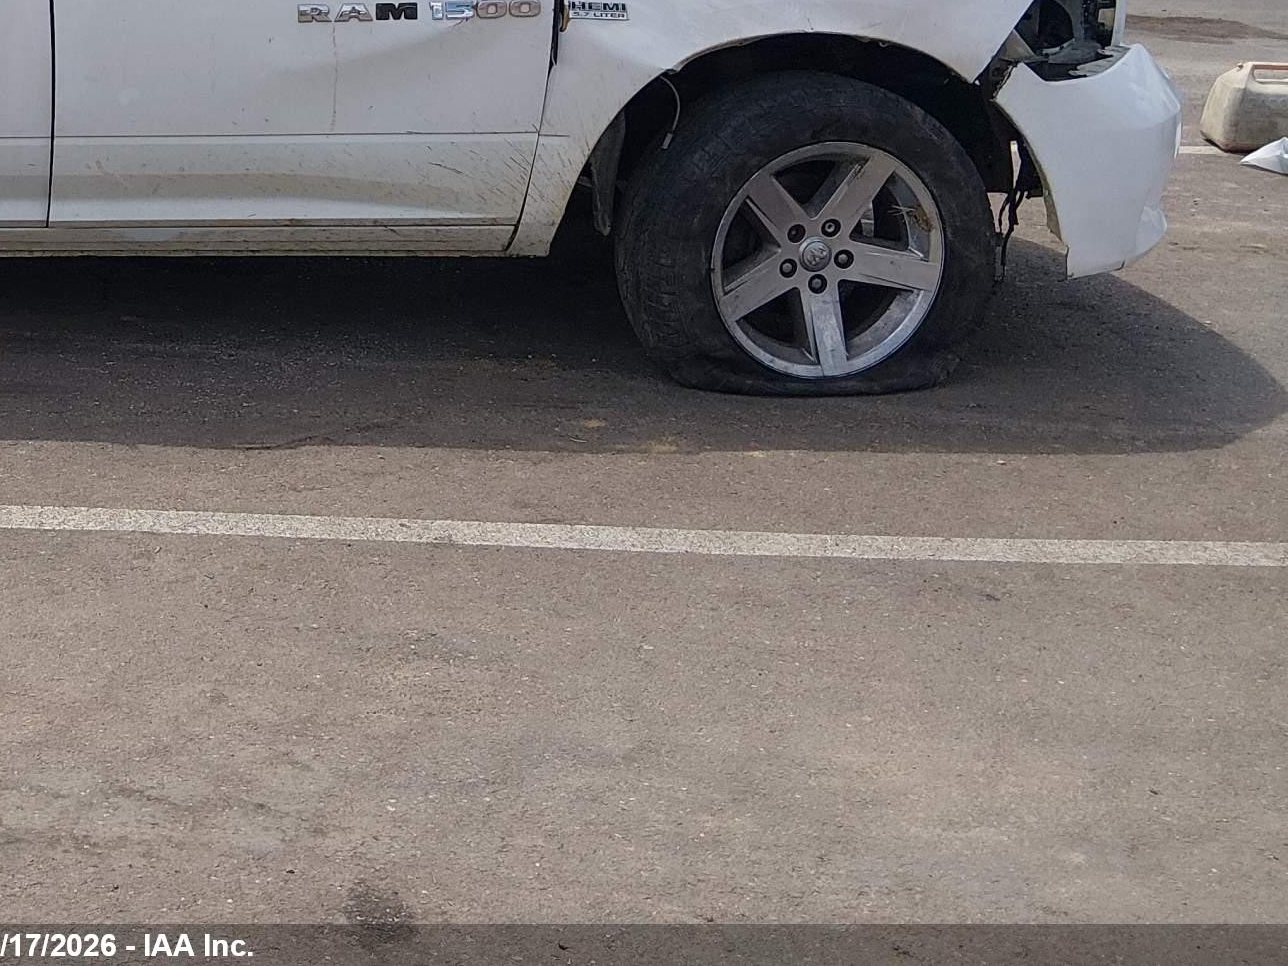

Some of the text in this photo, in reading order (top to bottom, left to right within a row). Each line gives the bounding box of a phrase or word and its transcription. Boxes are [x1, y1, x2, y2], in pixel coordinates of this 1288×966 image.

[568, 0, 627, 11] HEMI
[297, 2, 418, 23] RAM
[593, 11, 626, 19] LITER
